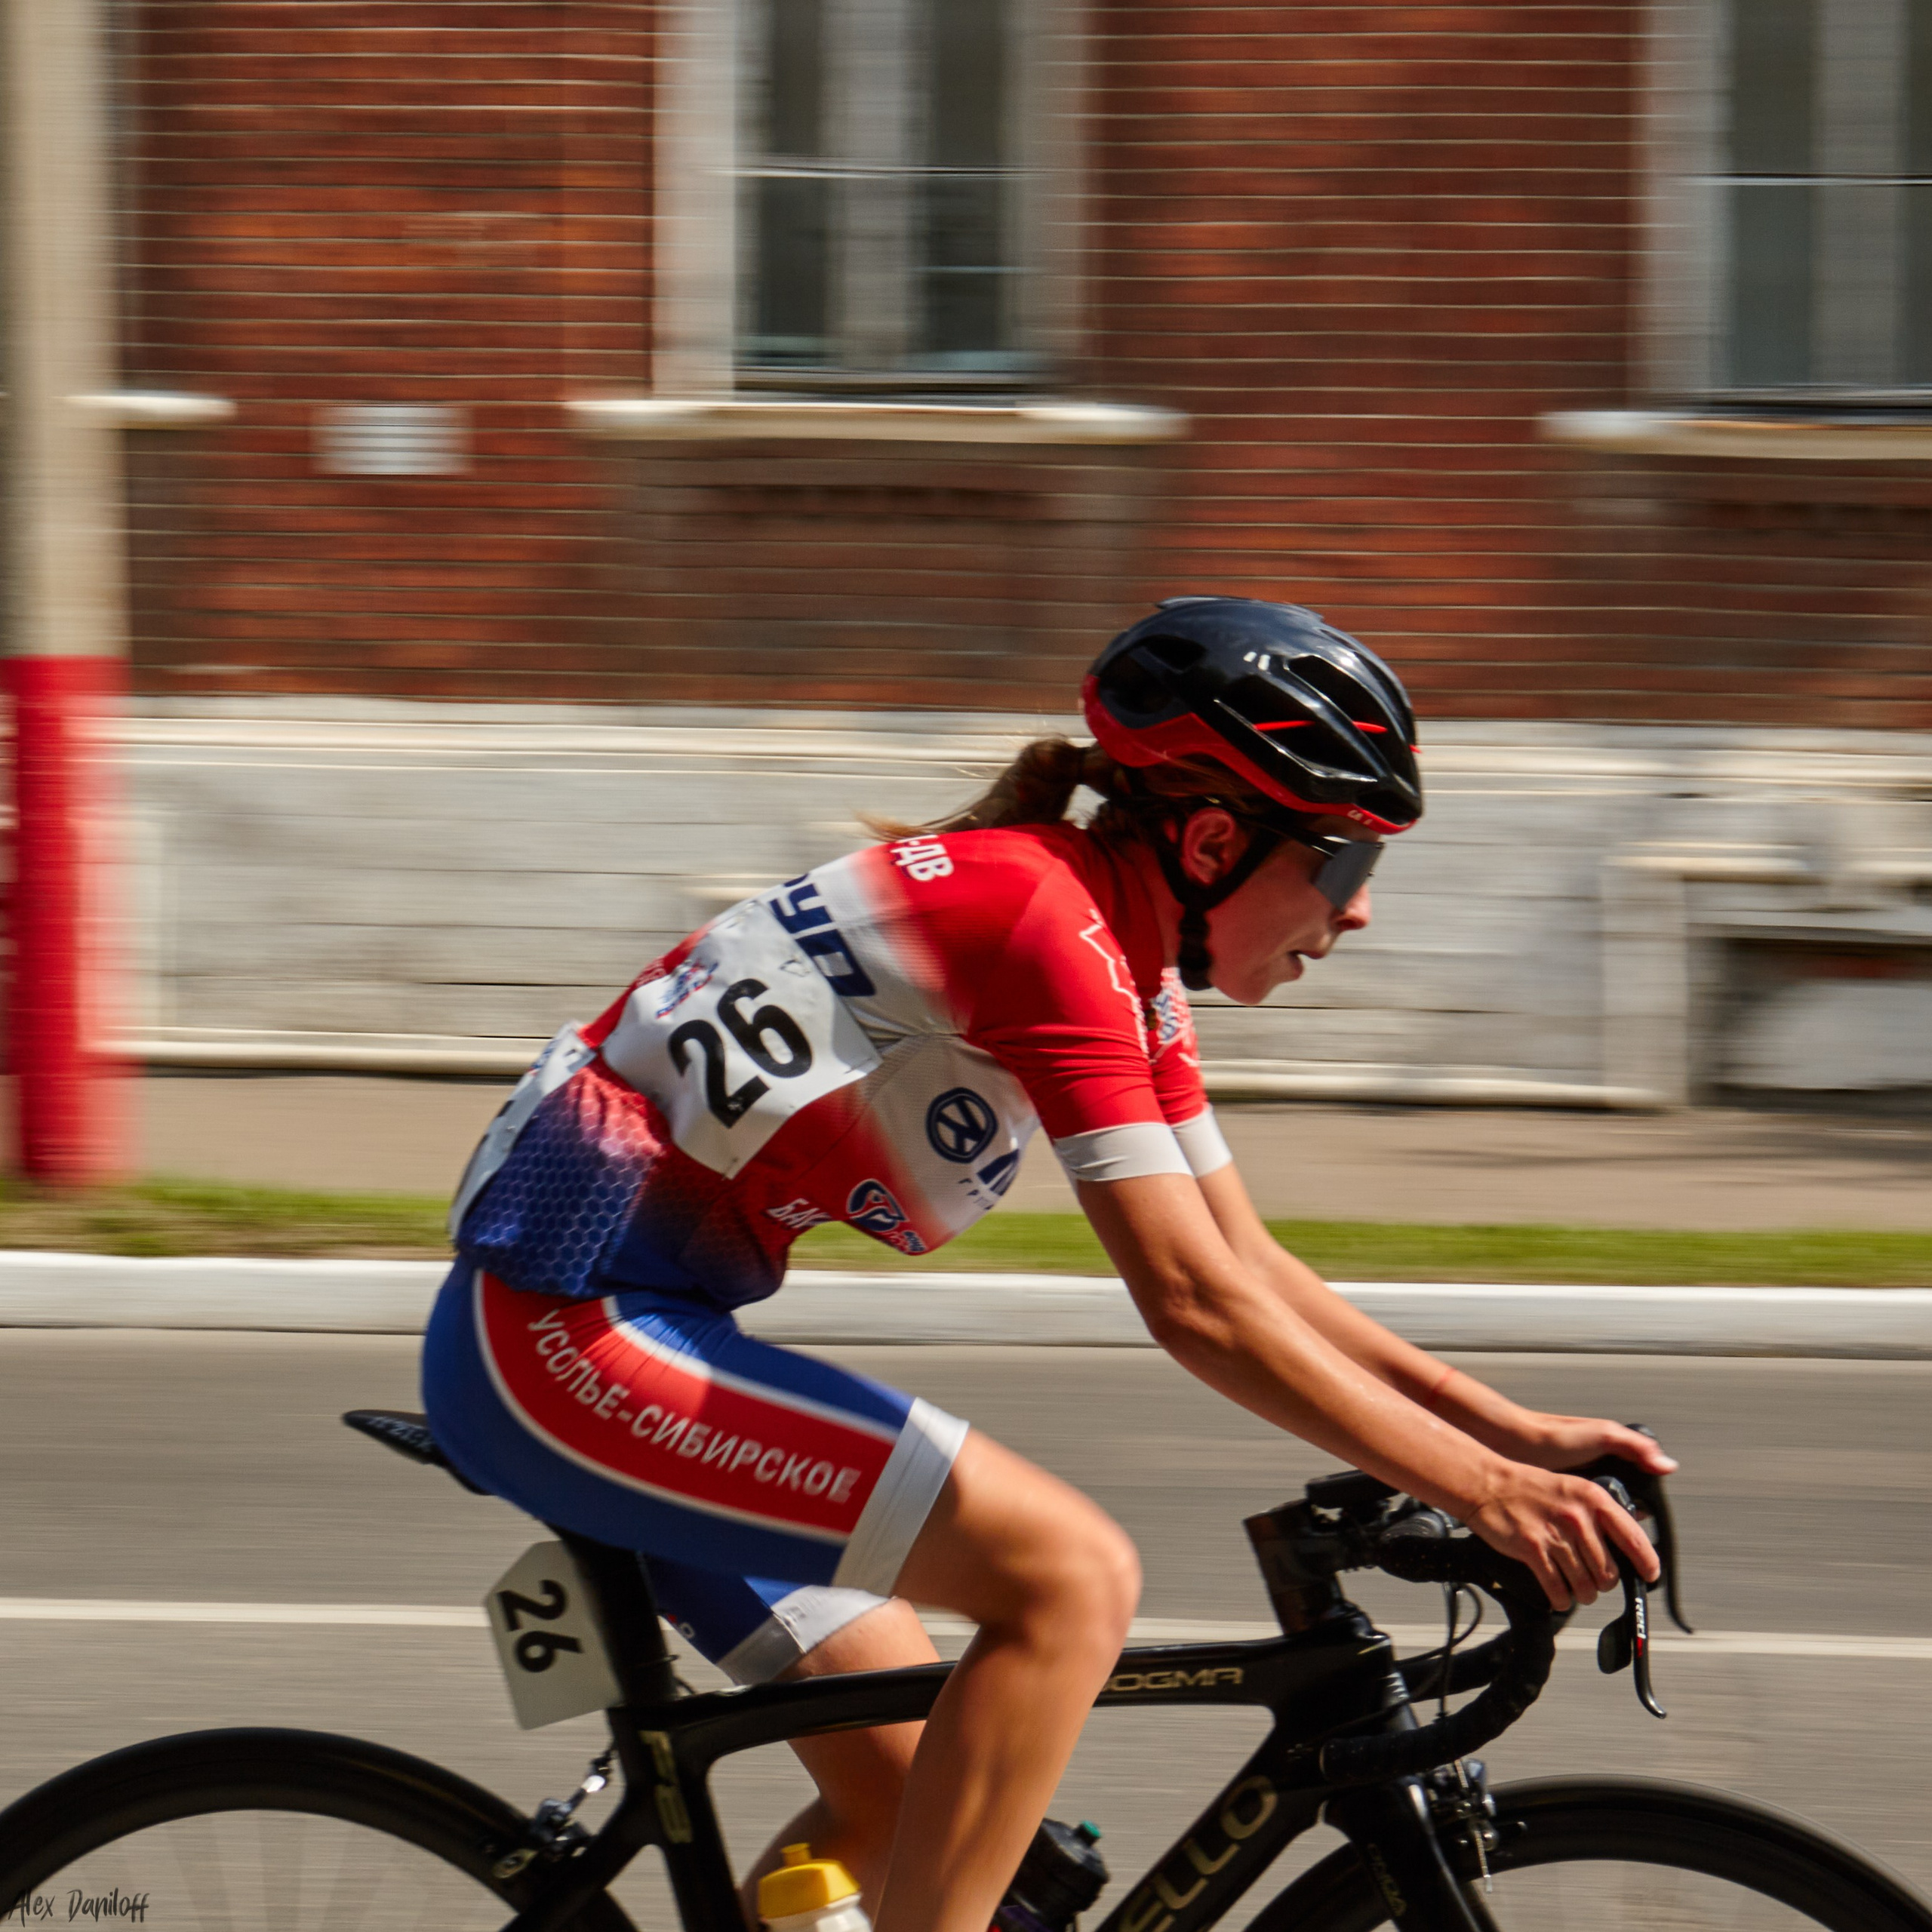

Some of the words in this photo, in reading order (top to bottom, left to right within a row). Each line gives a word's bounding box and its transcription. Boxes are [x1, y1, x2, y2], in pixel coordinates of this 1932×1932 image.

[668, 978, 814, 1129] 26
[528, 1309, 862, 1503] УСОЛЬЕ-СИБИРСКОЕ
[499, 1579, 585, 1673] 26
[1104, 1666, 1244, 1692] OGMA
